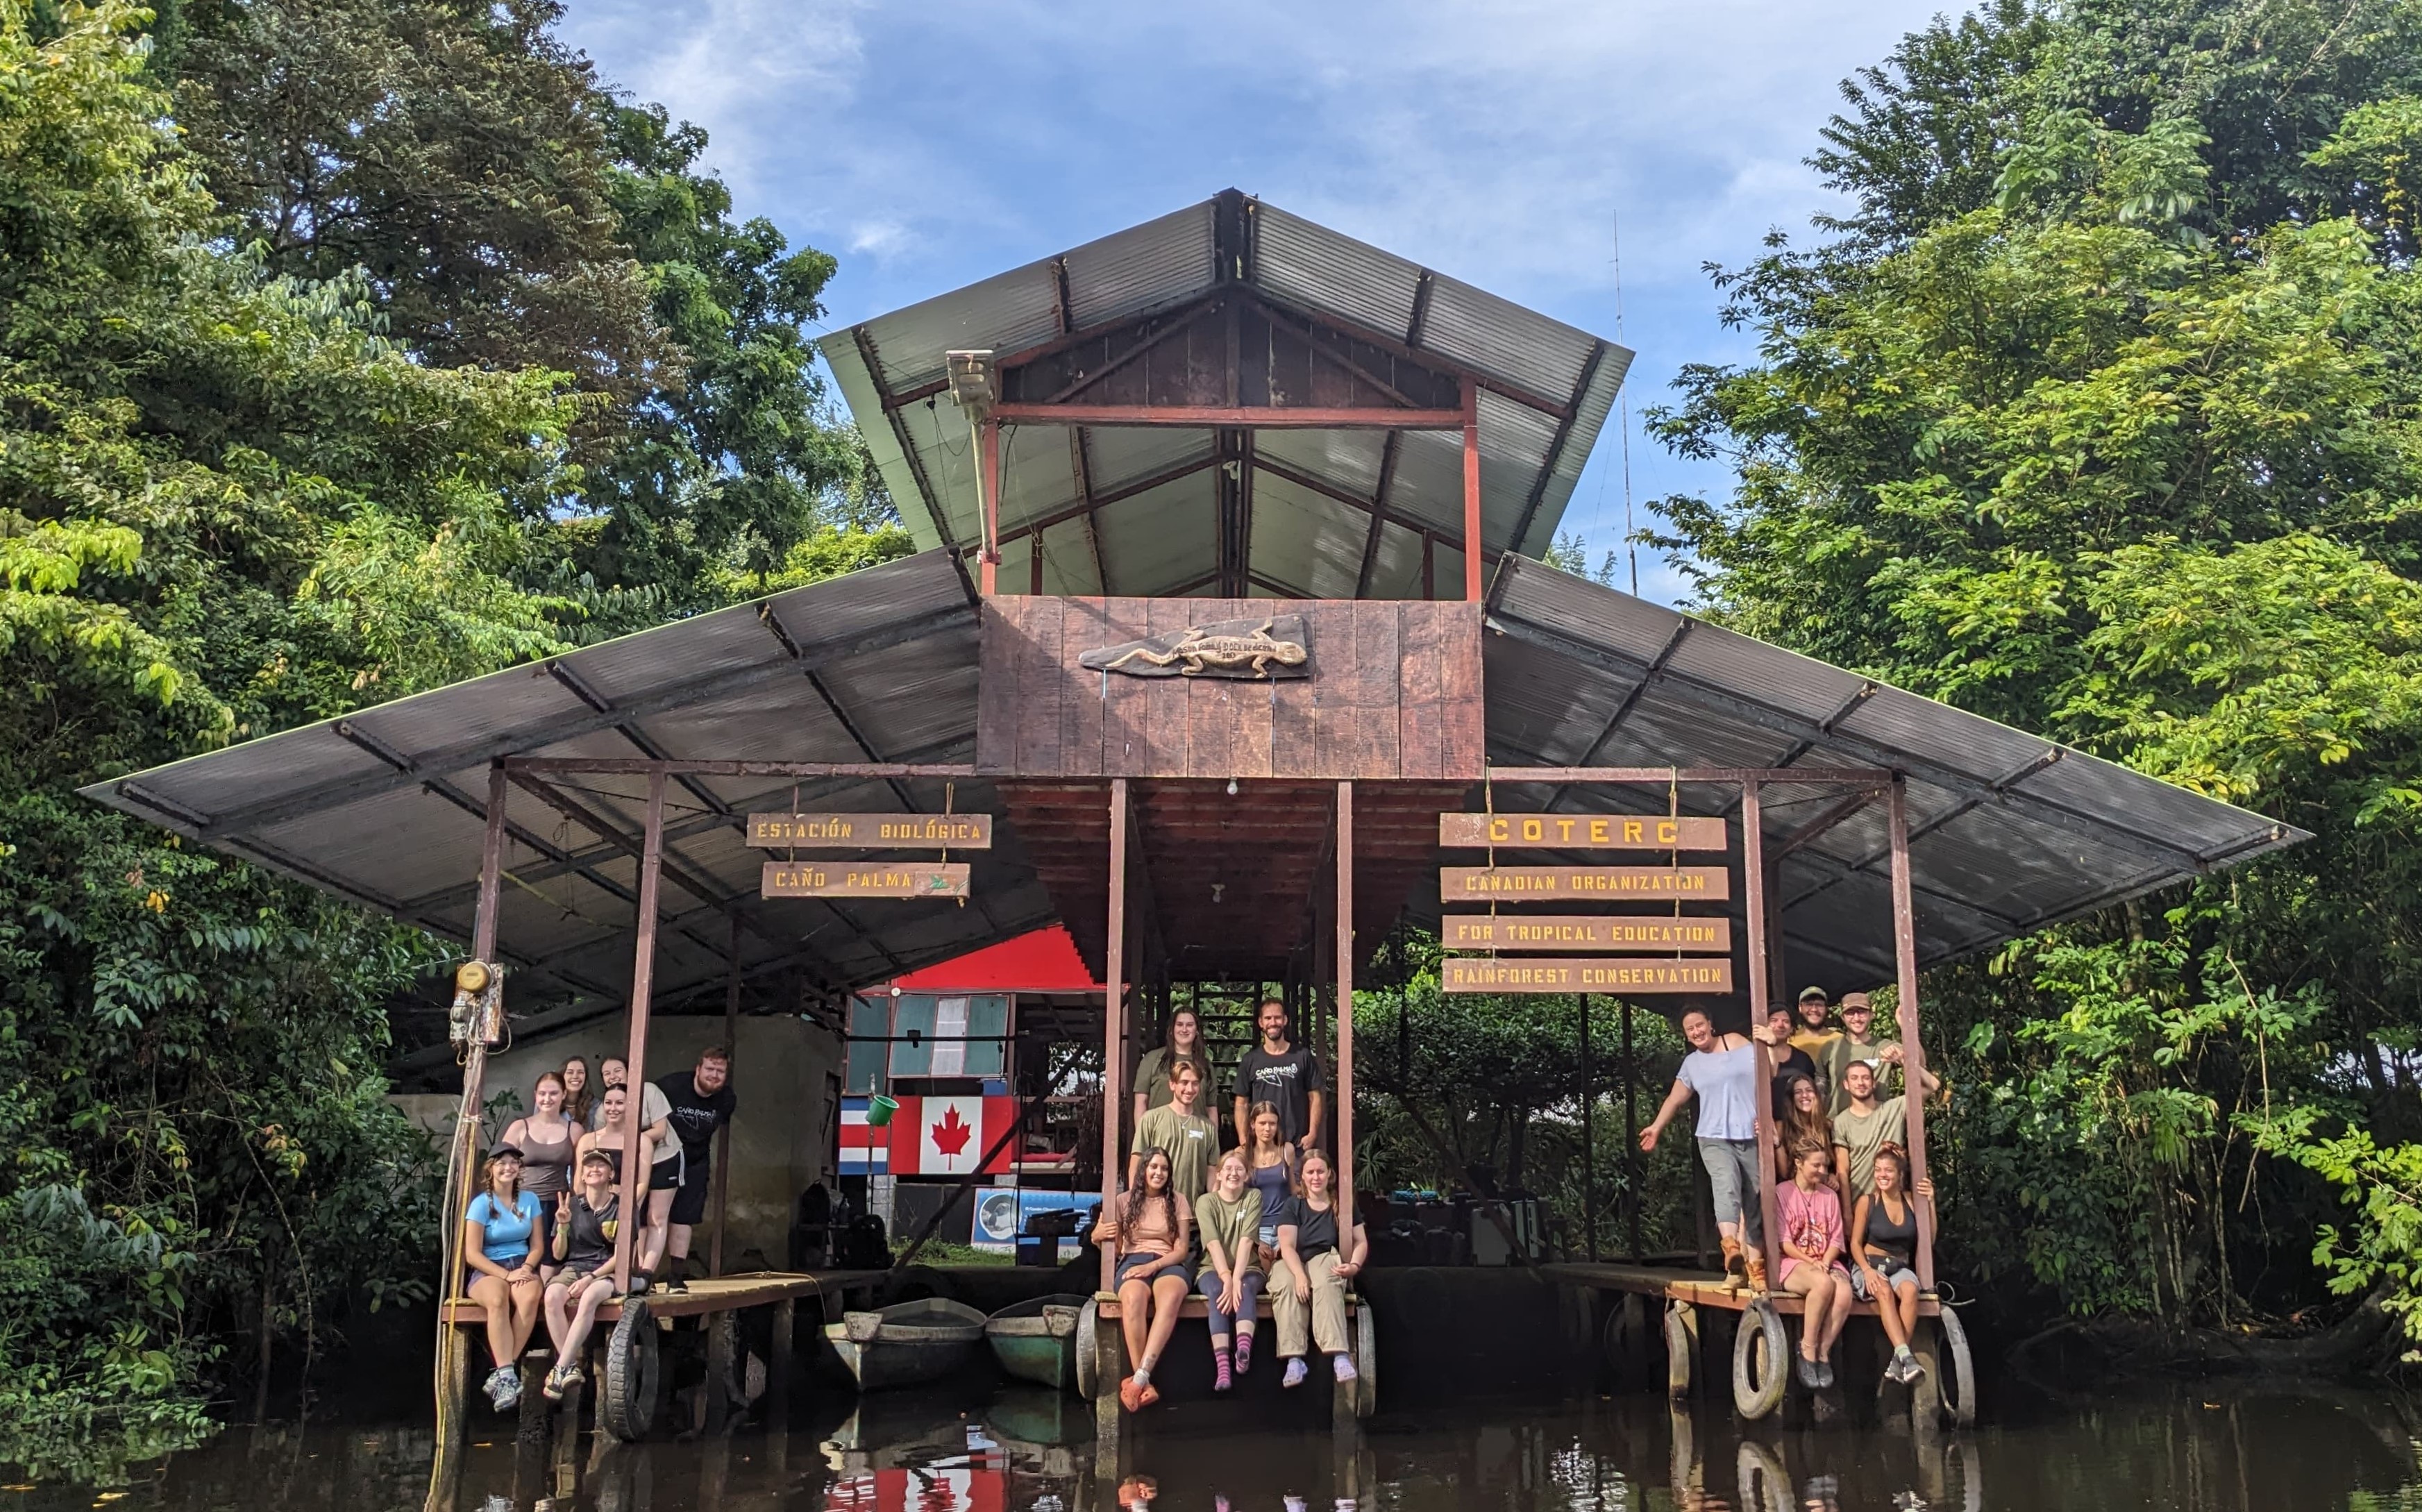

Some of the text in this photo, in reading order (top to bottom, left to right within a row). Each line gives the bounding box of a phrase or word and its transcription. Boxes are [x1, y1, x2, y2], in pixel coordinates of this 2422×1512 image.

[757, 817, 981, 840] ESTACIÓN BIOLÓGICA
[1488, 819, 1677, 843] COTERC
[775, 867, 912, 889] CAÑO PALMA
[1465, 875, 1704, 891] CANADIAN ORGANIZATION
[1458, 925, 1715, 943] FOR TROPICAL EDUCATION
[1453, 968, 1722, 984] RAINFOREST CONSERVATION
